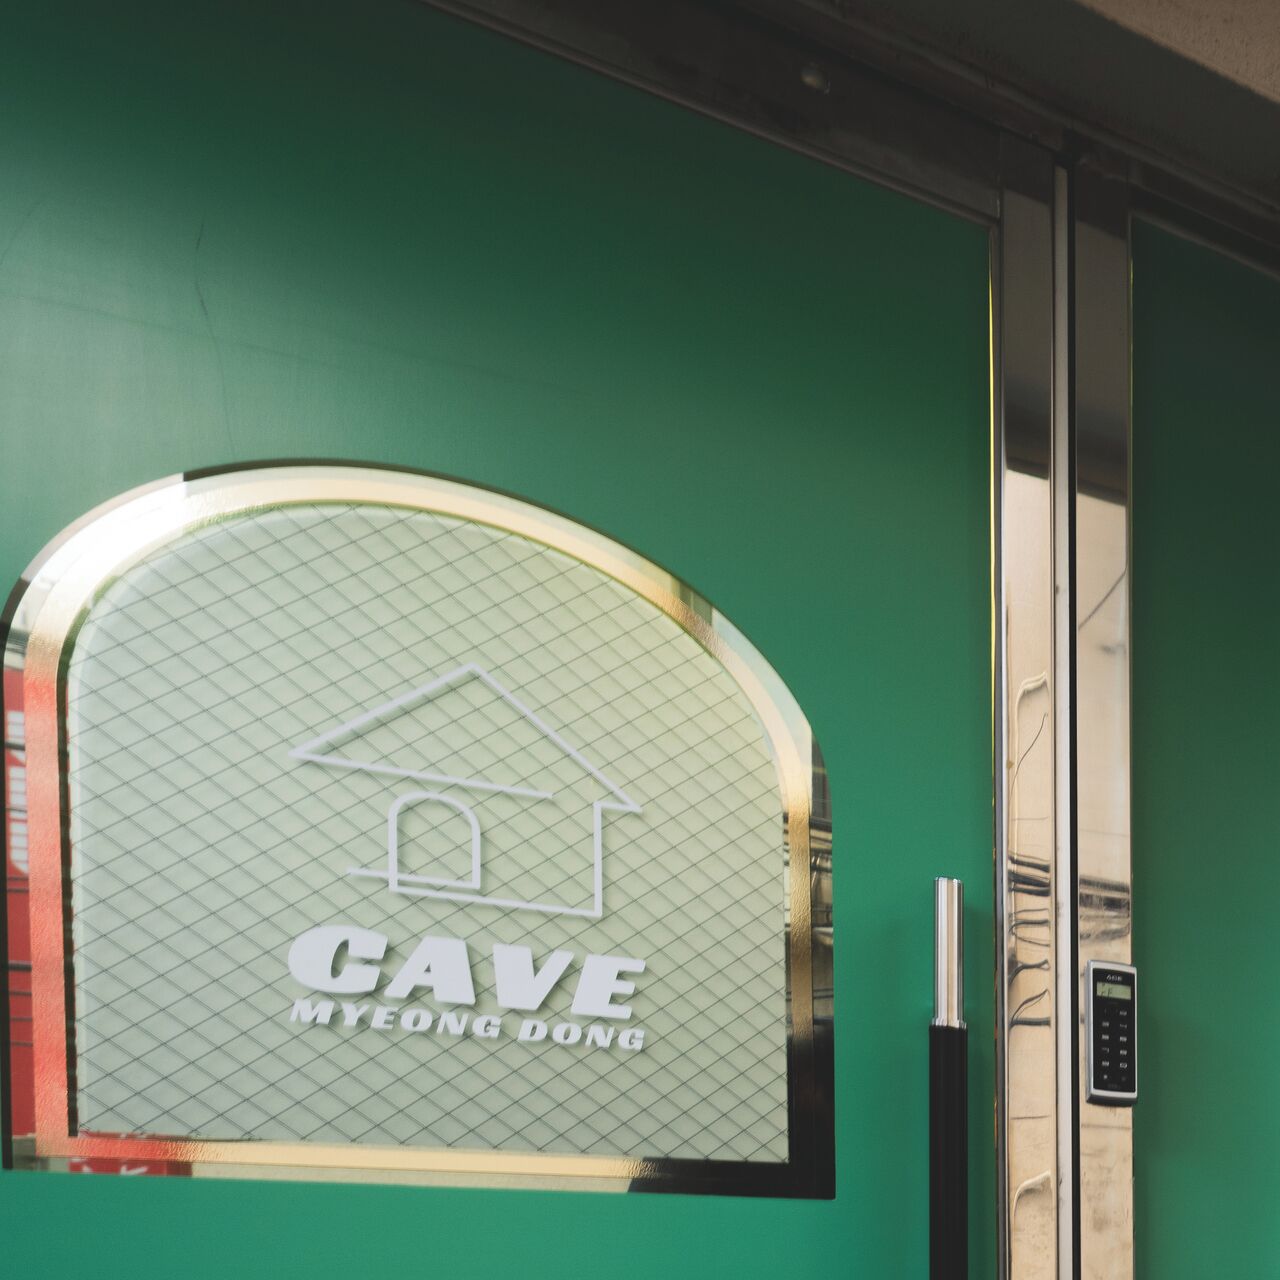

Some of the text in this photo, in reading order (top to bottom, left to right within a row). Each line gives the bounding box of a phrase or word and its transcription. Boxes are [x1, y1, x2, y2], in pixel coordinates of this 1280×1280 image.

[288, 924, 646, 1020] CAVE
[289, 998, 646, 1052] MYEONG DONG
